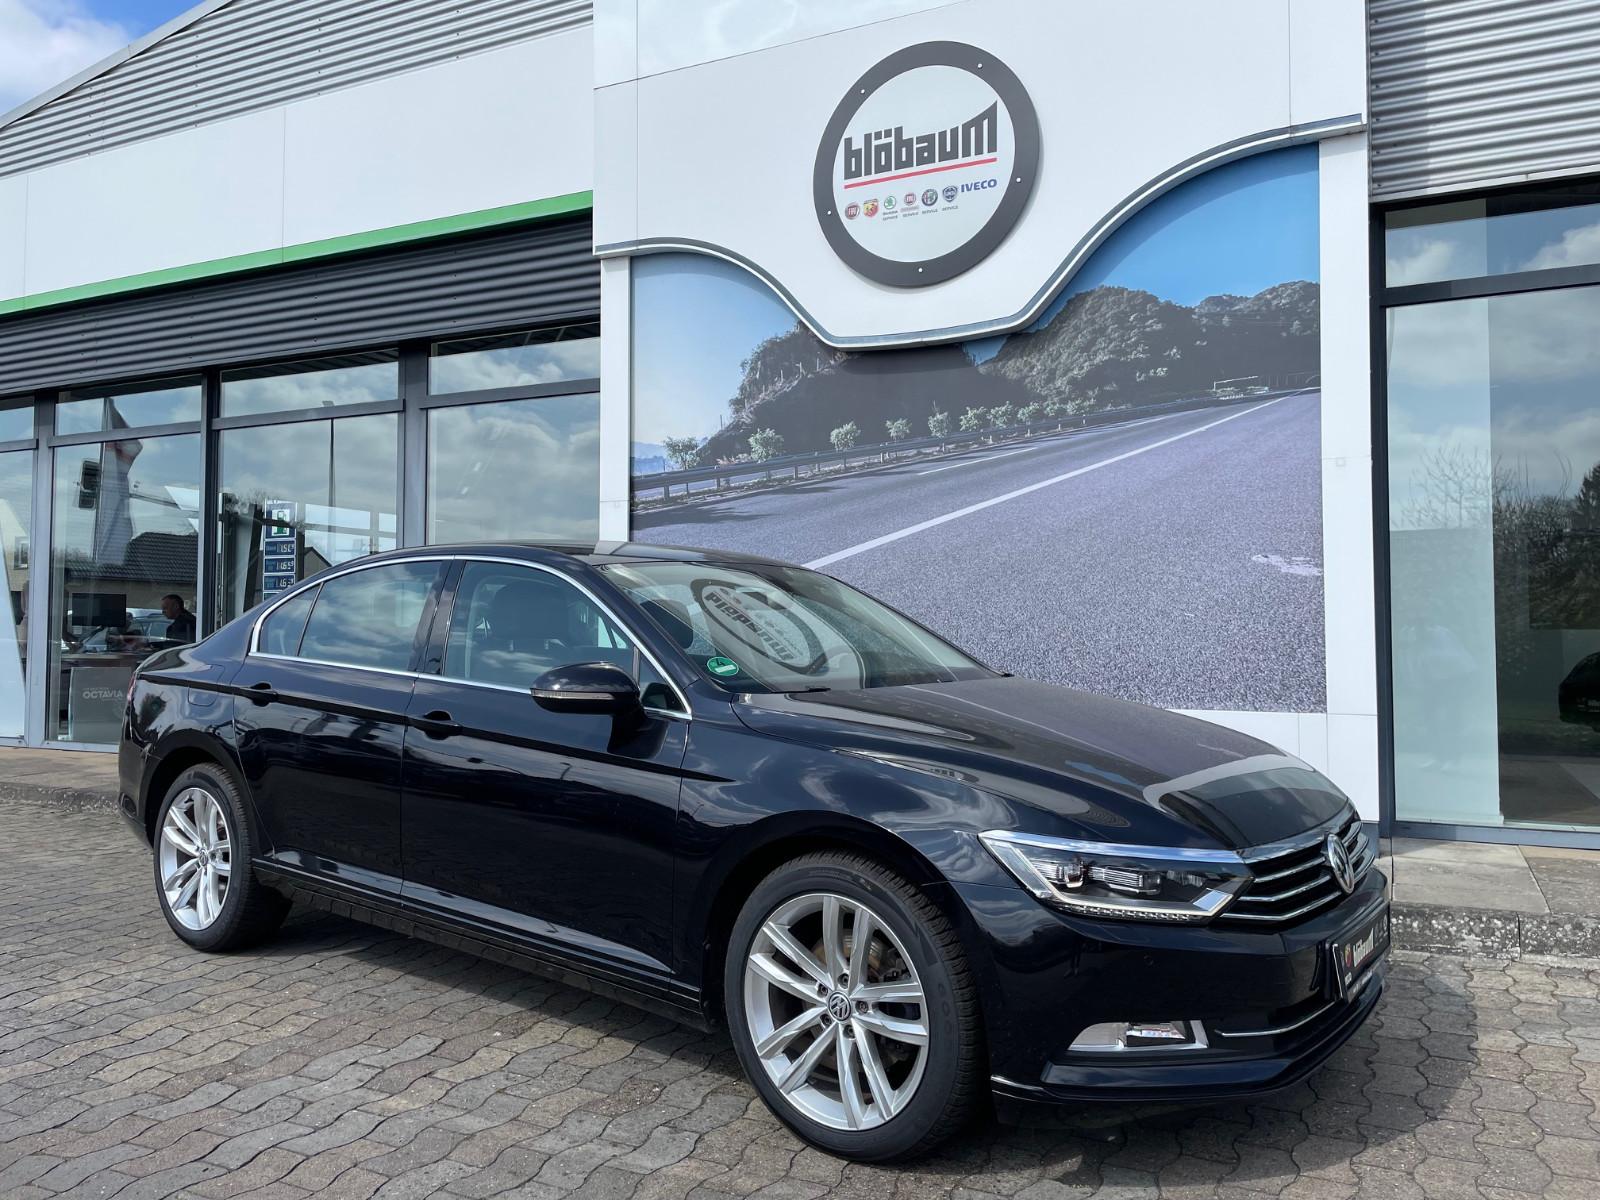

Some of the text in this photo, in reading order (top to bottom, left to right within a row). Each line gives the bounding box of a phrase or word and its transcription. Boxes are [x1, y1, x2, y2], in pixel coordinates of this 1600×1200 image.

[844, 100, 997, 180] blöbaum
[961, 179, 997, 192] IVECO
[82, 690, 124, 699] OCTAVIA
